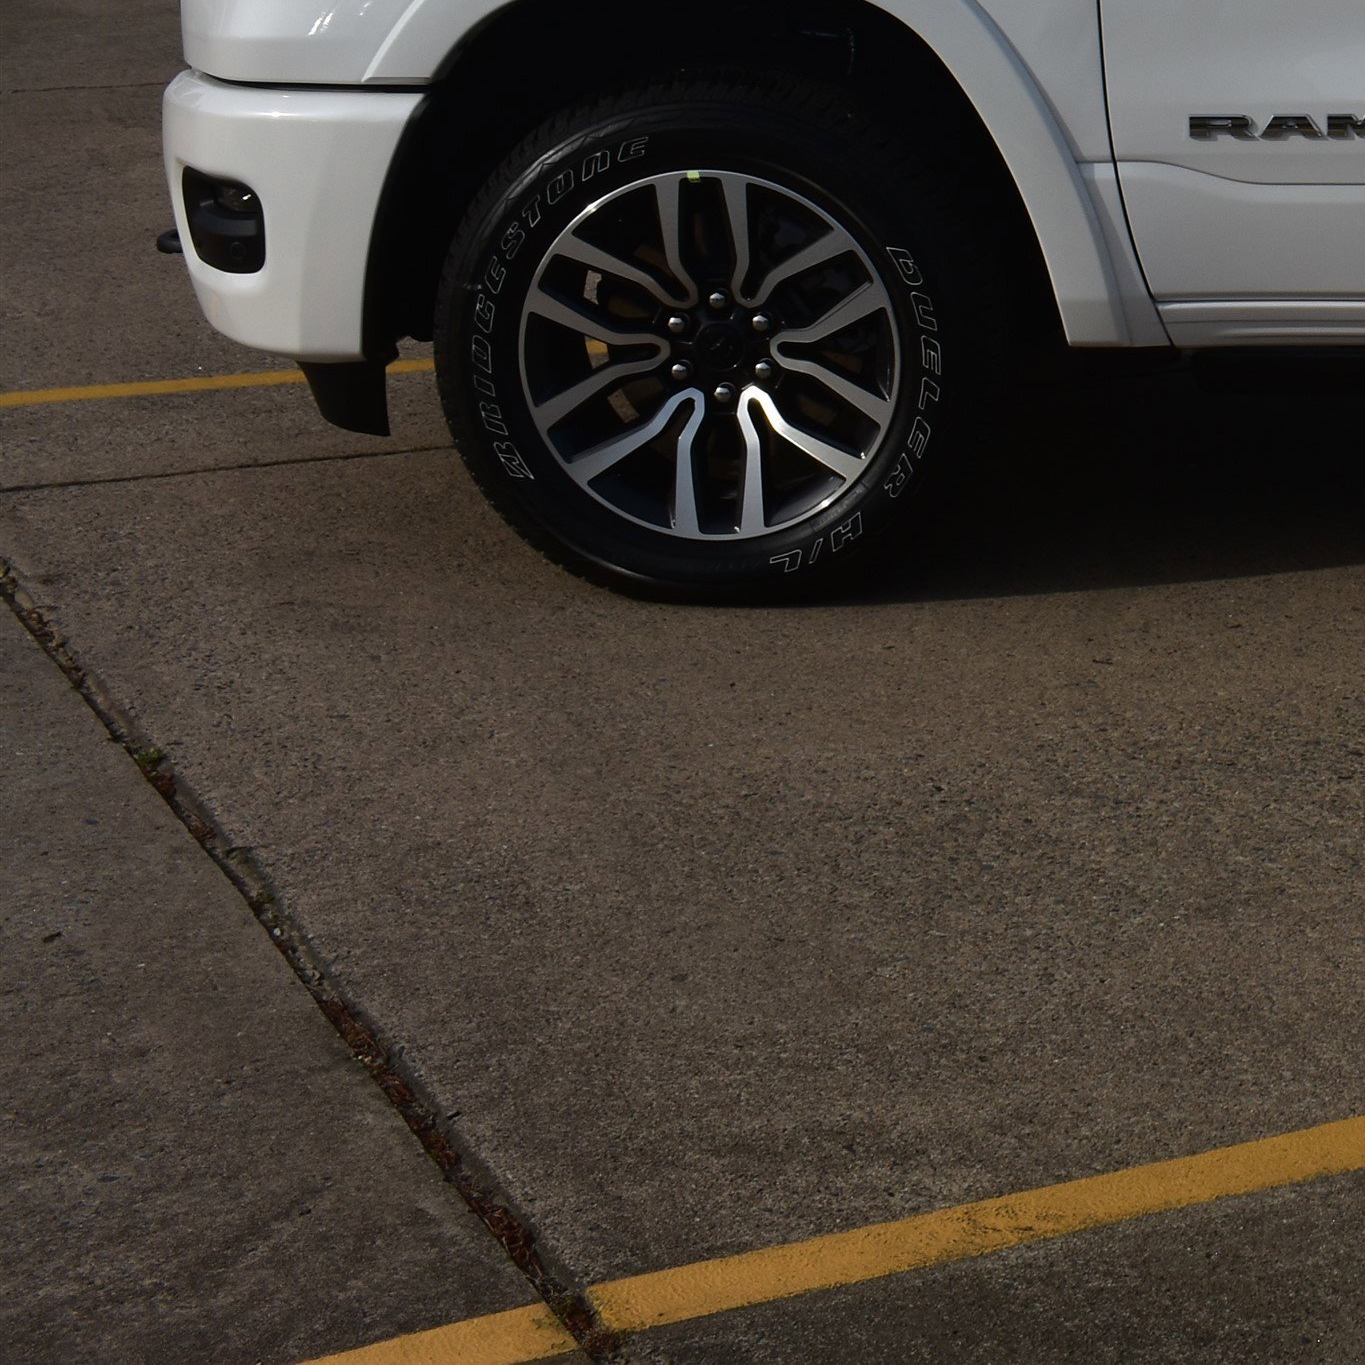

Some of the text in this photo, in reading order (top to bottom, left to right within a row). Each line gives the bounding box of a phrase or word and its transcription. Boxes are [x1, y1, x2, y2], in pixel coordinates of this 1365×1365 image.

[471, 135, 649, 482] BRIDGESTONE
[769, 245, 942, 574] DUELER H/L
